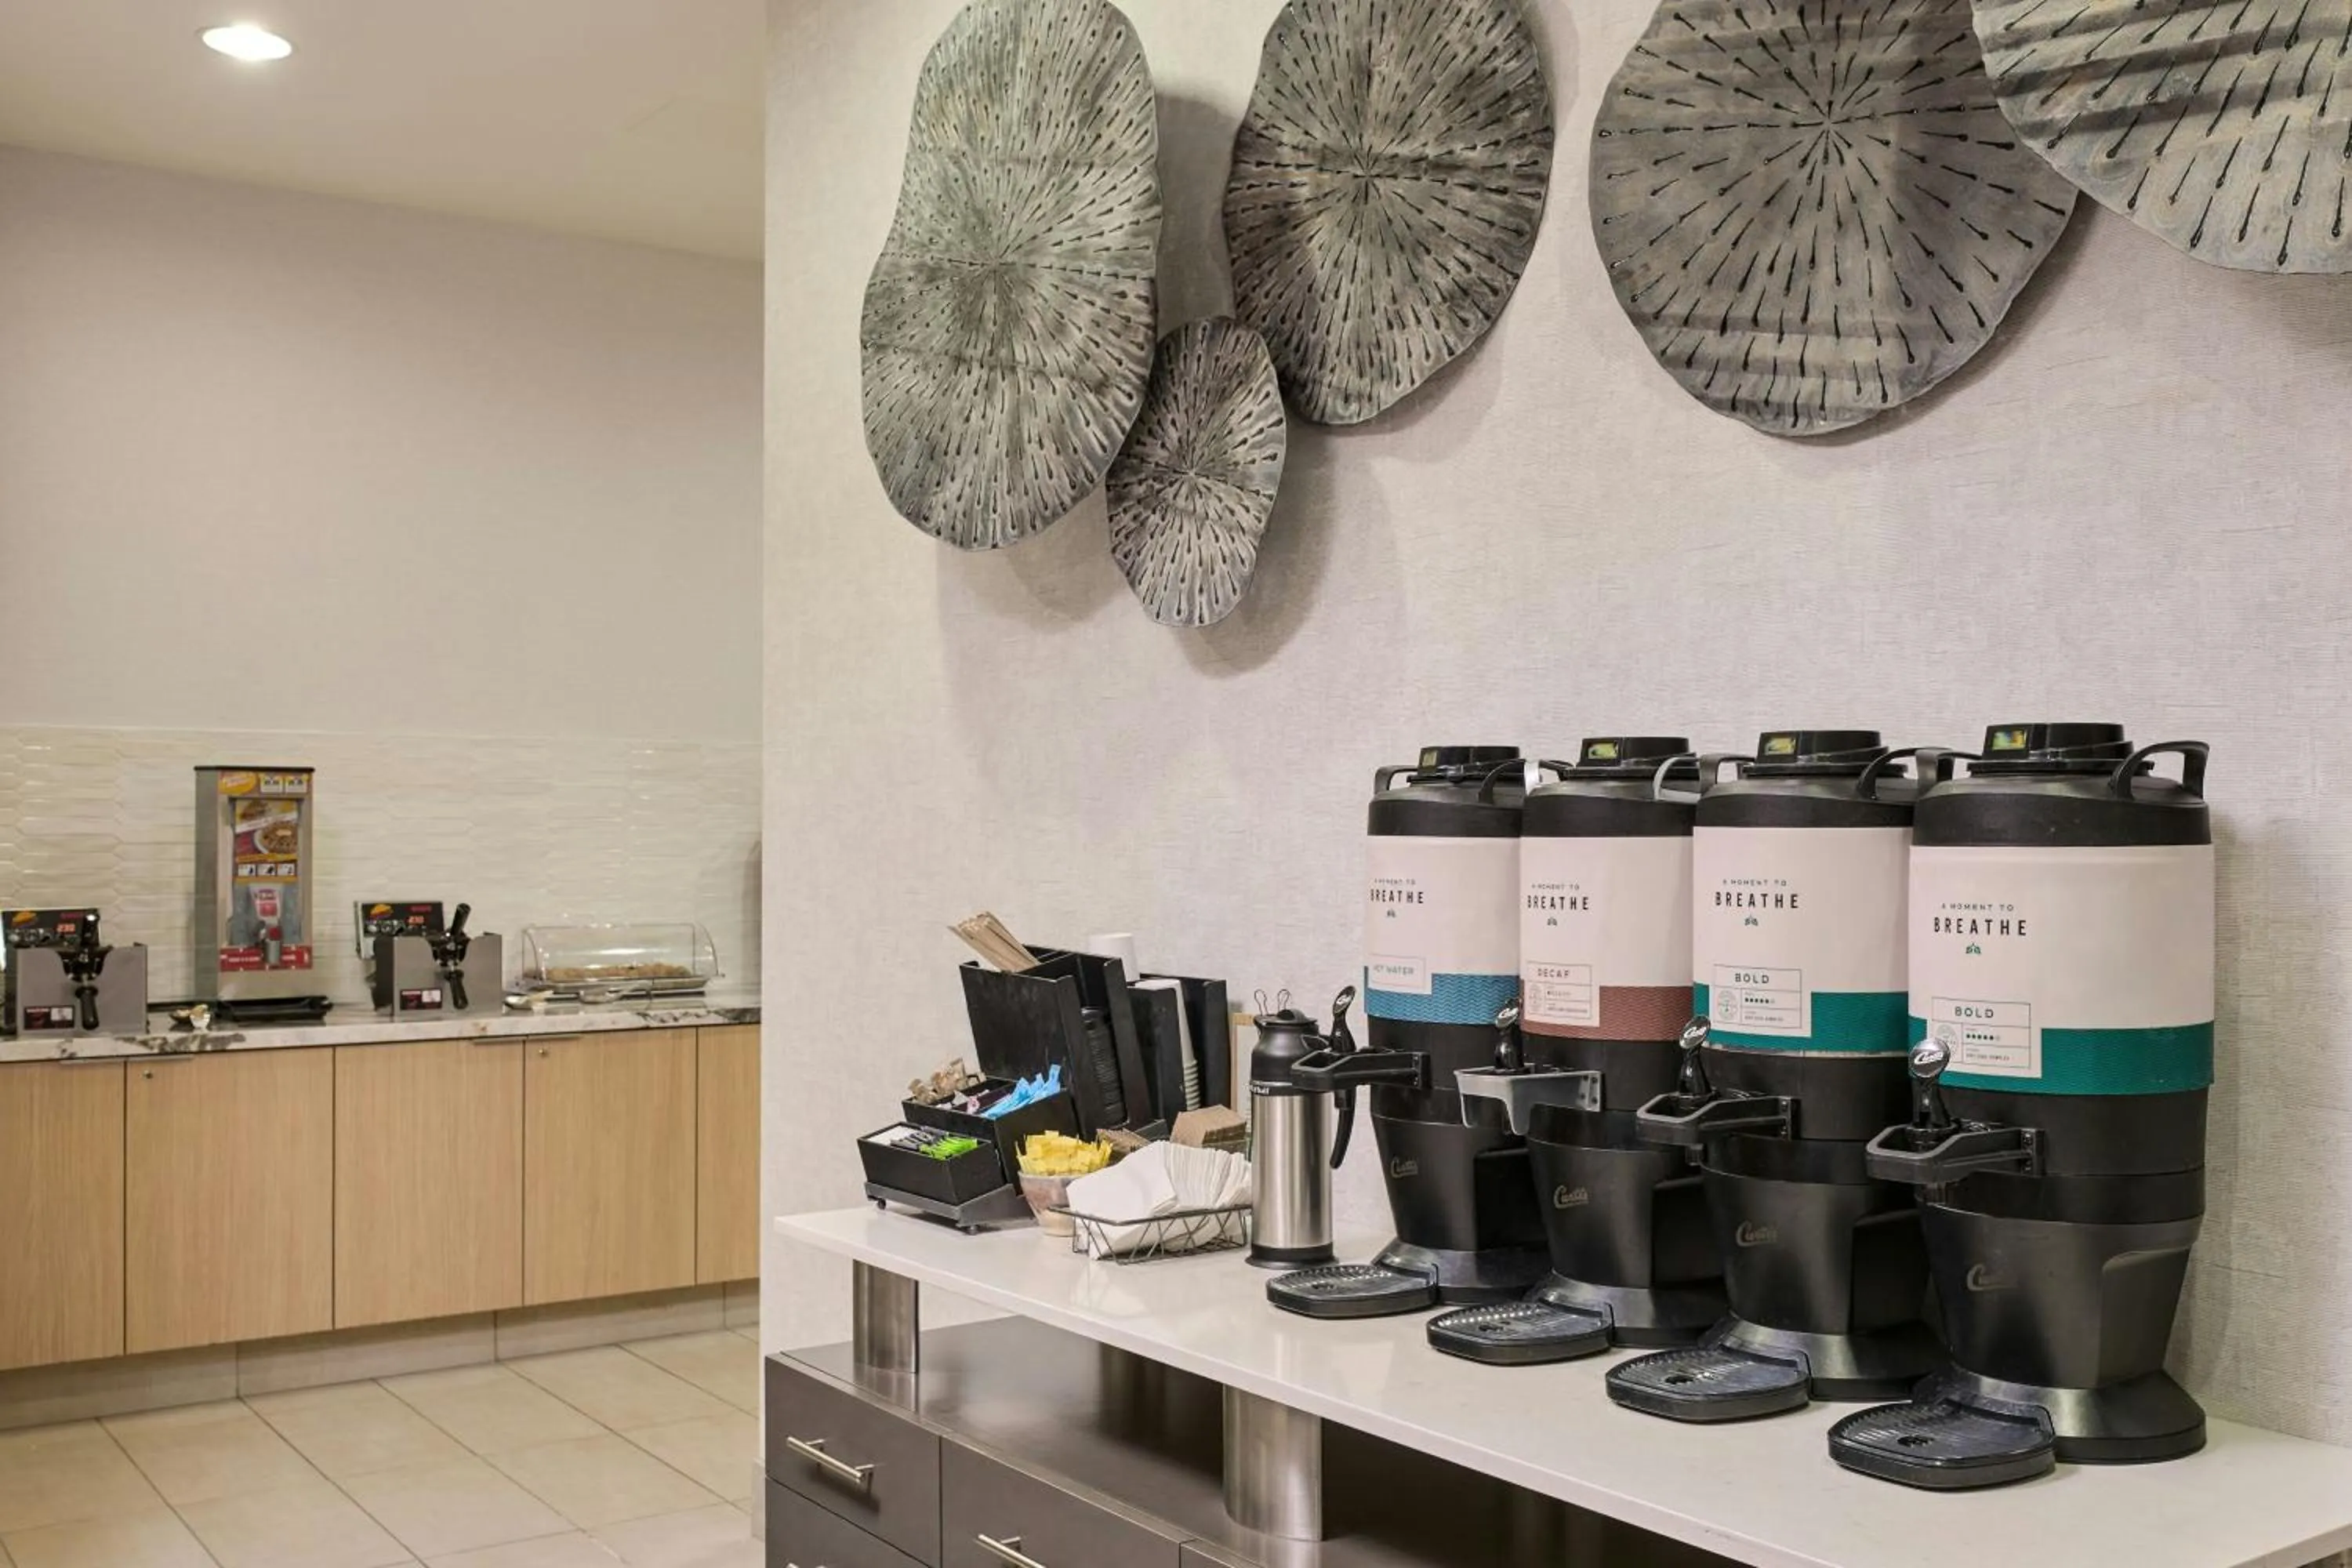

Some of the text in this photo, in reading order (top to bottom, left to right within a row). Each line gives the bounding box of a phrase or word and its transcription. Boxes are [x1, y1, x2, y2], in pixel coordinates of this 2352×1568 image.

[1370, 888, 1424, 904] BREATHE
[1527, 895, 1589, 910] BREATHE
[1715, 891, 1799, 909] BREATHE
[1933, 916, 2027, 936] BREATHE
[1537, 967, 1570, 978] DECAF
[1734, 973, 1770, 984] BOLD
[1955, 1006, 1994, 1018] BOLD
